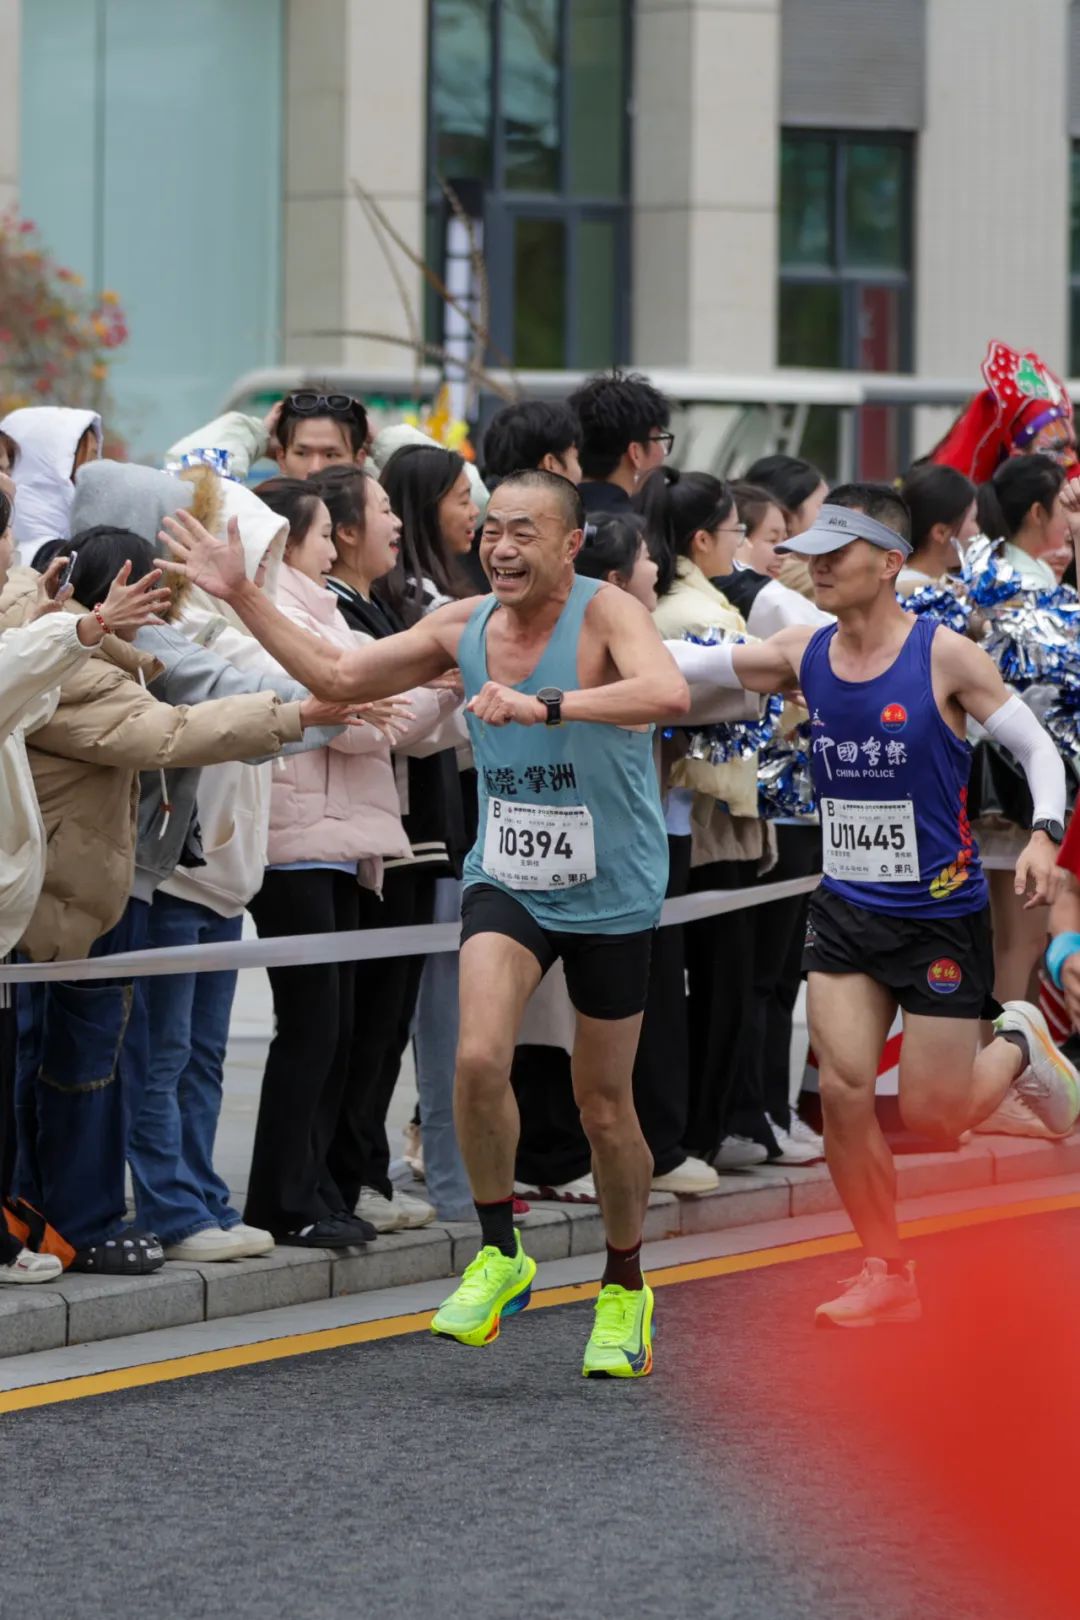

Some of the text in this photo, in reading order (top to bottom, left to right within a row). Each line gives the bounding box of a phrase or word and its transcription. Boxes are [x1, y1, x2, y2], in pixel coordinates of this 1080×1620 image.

[836, 768, 895, 778] CHINA POLICE
[493, 801, 502, 819] B
[826, 800, 835, 817] B
[499, 826, 573, 859] 10394
[830, 822, 906, 851] U11445
[894, 864, 914, 874] 果凡
